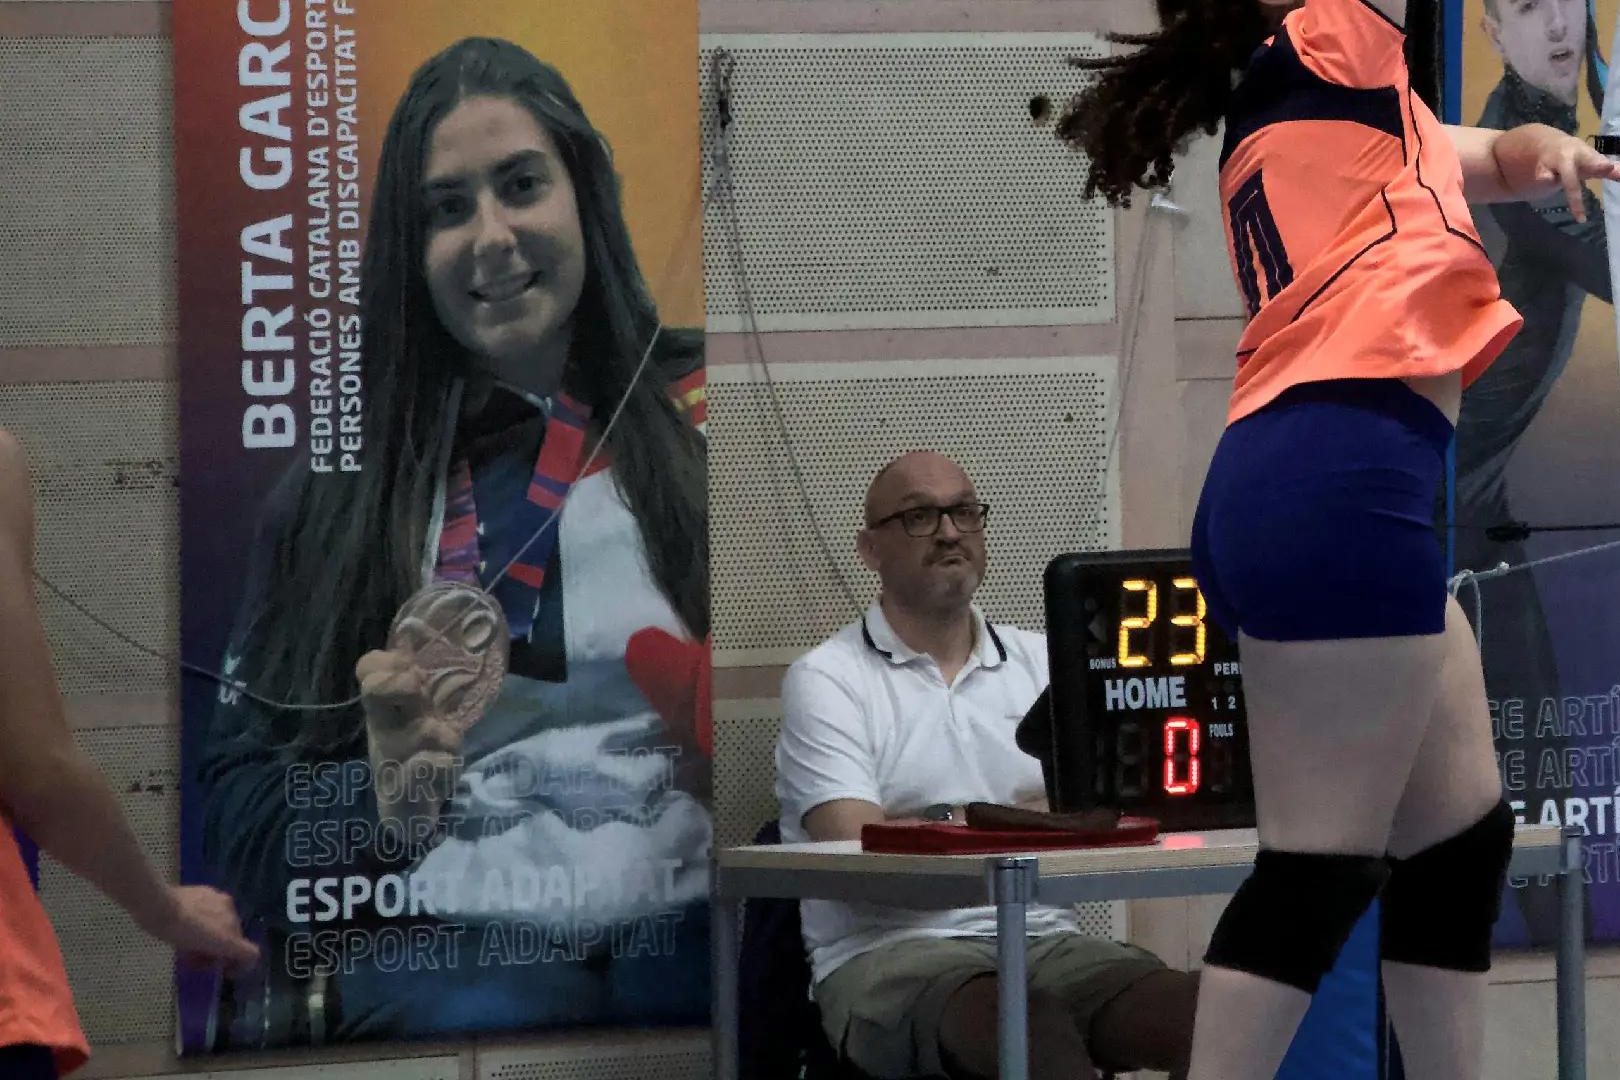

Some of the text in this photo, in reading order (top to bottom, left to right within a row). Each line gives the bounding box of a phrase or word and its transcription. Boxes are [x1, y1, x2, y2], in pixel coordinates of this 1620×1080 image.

[333, 26, 361, 230] DISCAPACITAT
[306, 146, 331, 299] CATALANA
[336, 241, 361, 306] AMB
[240, 214, 296, 449] BERTA
[304, 307, 333, 473] FEDERACIÓ
[337, 313, 362, 473] PERSONES
[1117, 577, 1207, 667] 23
[1089, 658, 1241, 676] BONUS PER
[1104, 676, 1187, 711] HOME
[1209, 723, 1234, 737] FOULS
[1211, 696, 1237, 710] 1 2
[285, 756, 464, 808] ESPORT
[1164, 717, 1200, 795] 0
[285, 815, 464, 867] ESPORT
[286, 873, 464, 922] ESPORT
[285, 911, 684, 978] ESPORT ADAPTAT
